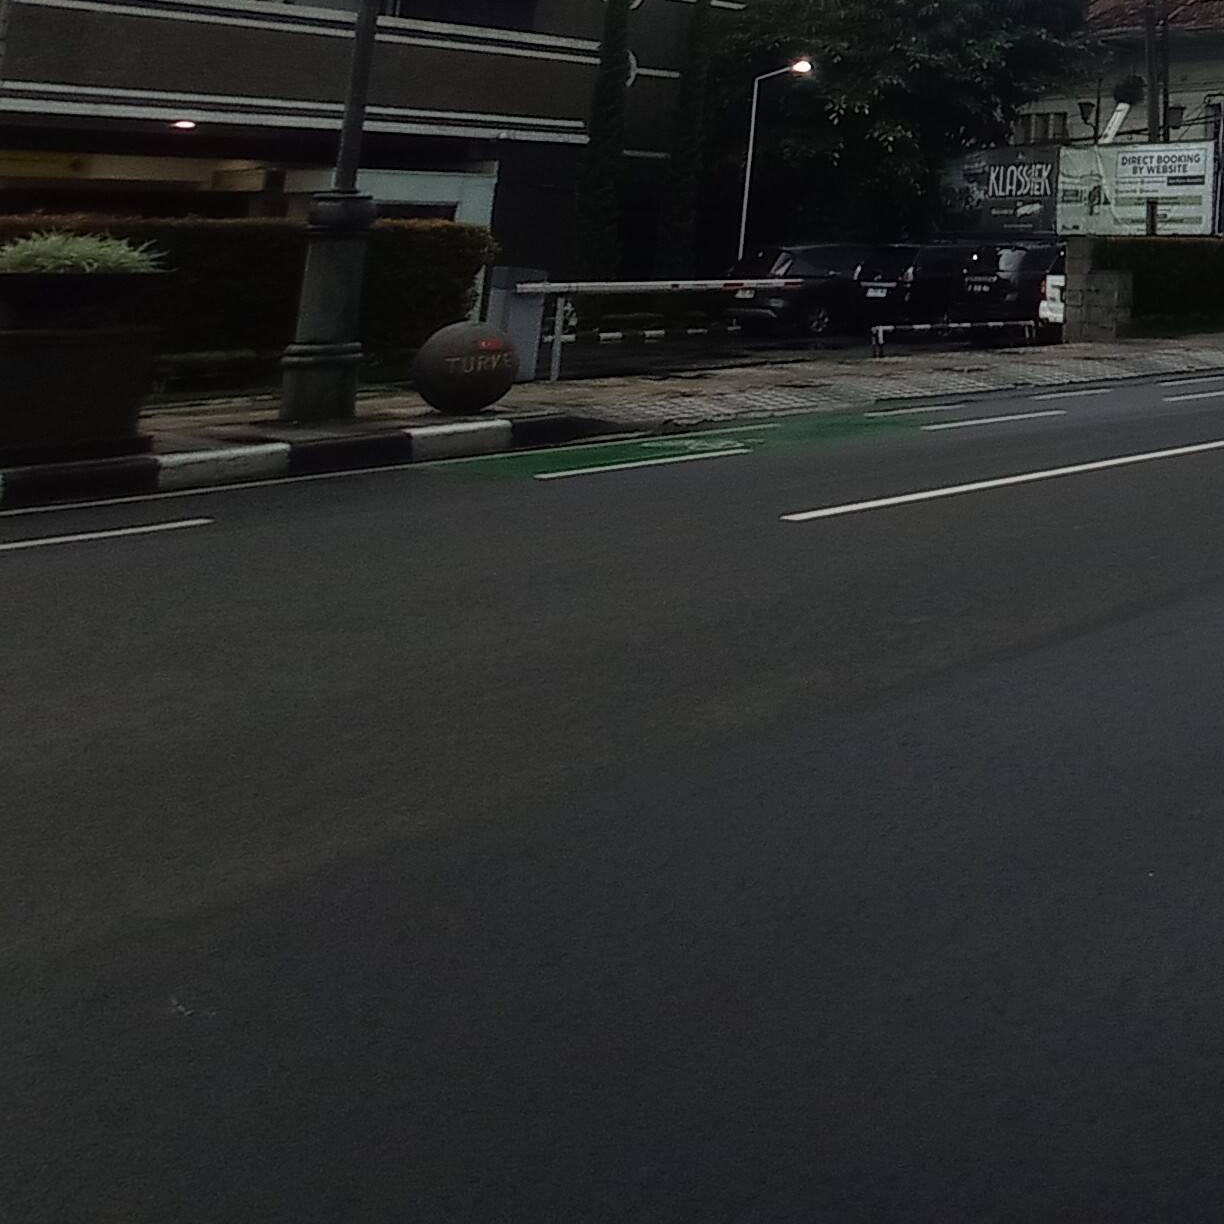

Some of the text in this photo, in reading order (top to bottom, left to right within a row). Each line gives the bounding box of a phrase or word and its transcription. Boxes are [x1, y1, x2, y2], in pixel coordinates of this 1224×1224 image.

[1121, 153, 1201, 166] DIRECT BOOKING
[1132, 163, 1188, 175] BY WEBSITE
